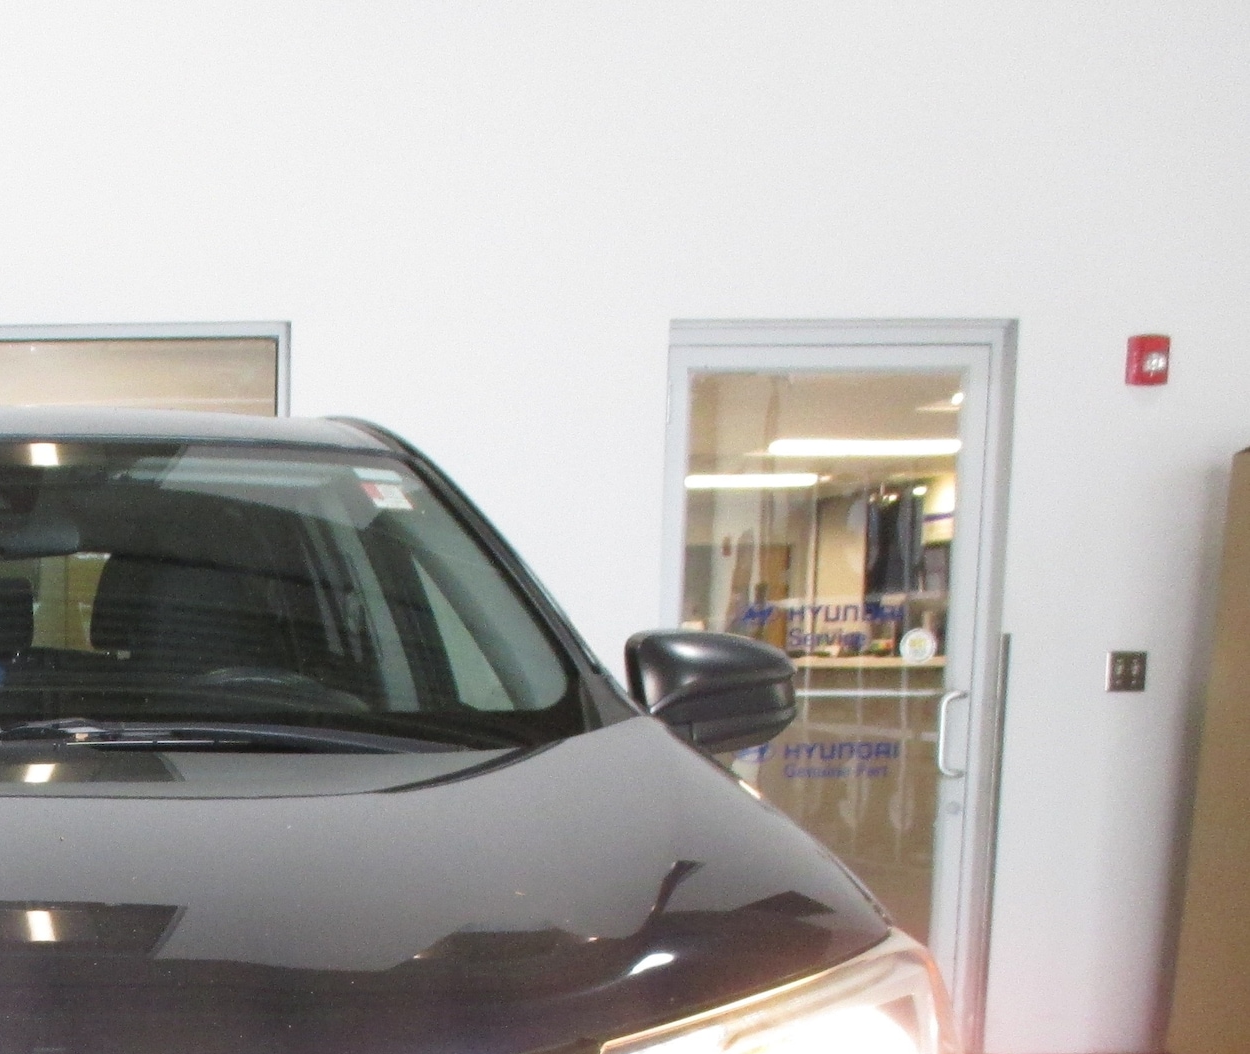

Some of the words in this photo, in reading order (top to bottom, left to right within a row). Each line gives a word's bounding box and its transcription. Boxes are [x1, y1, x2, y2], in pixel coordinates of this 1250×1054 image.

[787, 602, 905, 622] HYUNDAI
[788, 628, 867, 649] Service
[784, 742, 899, 761] HYUNDAI
